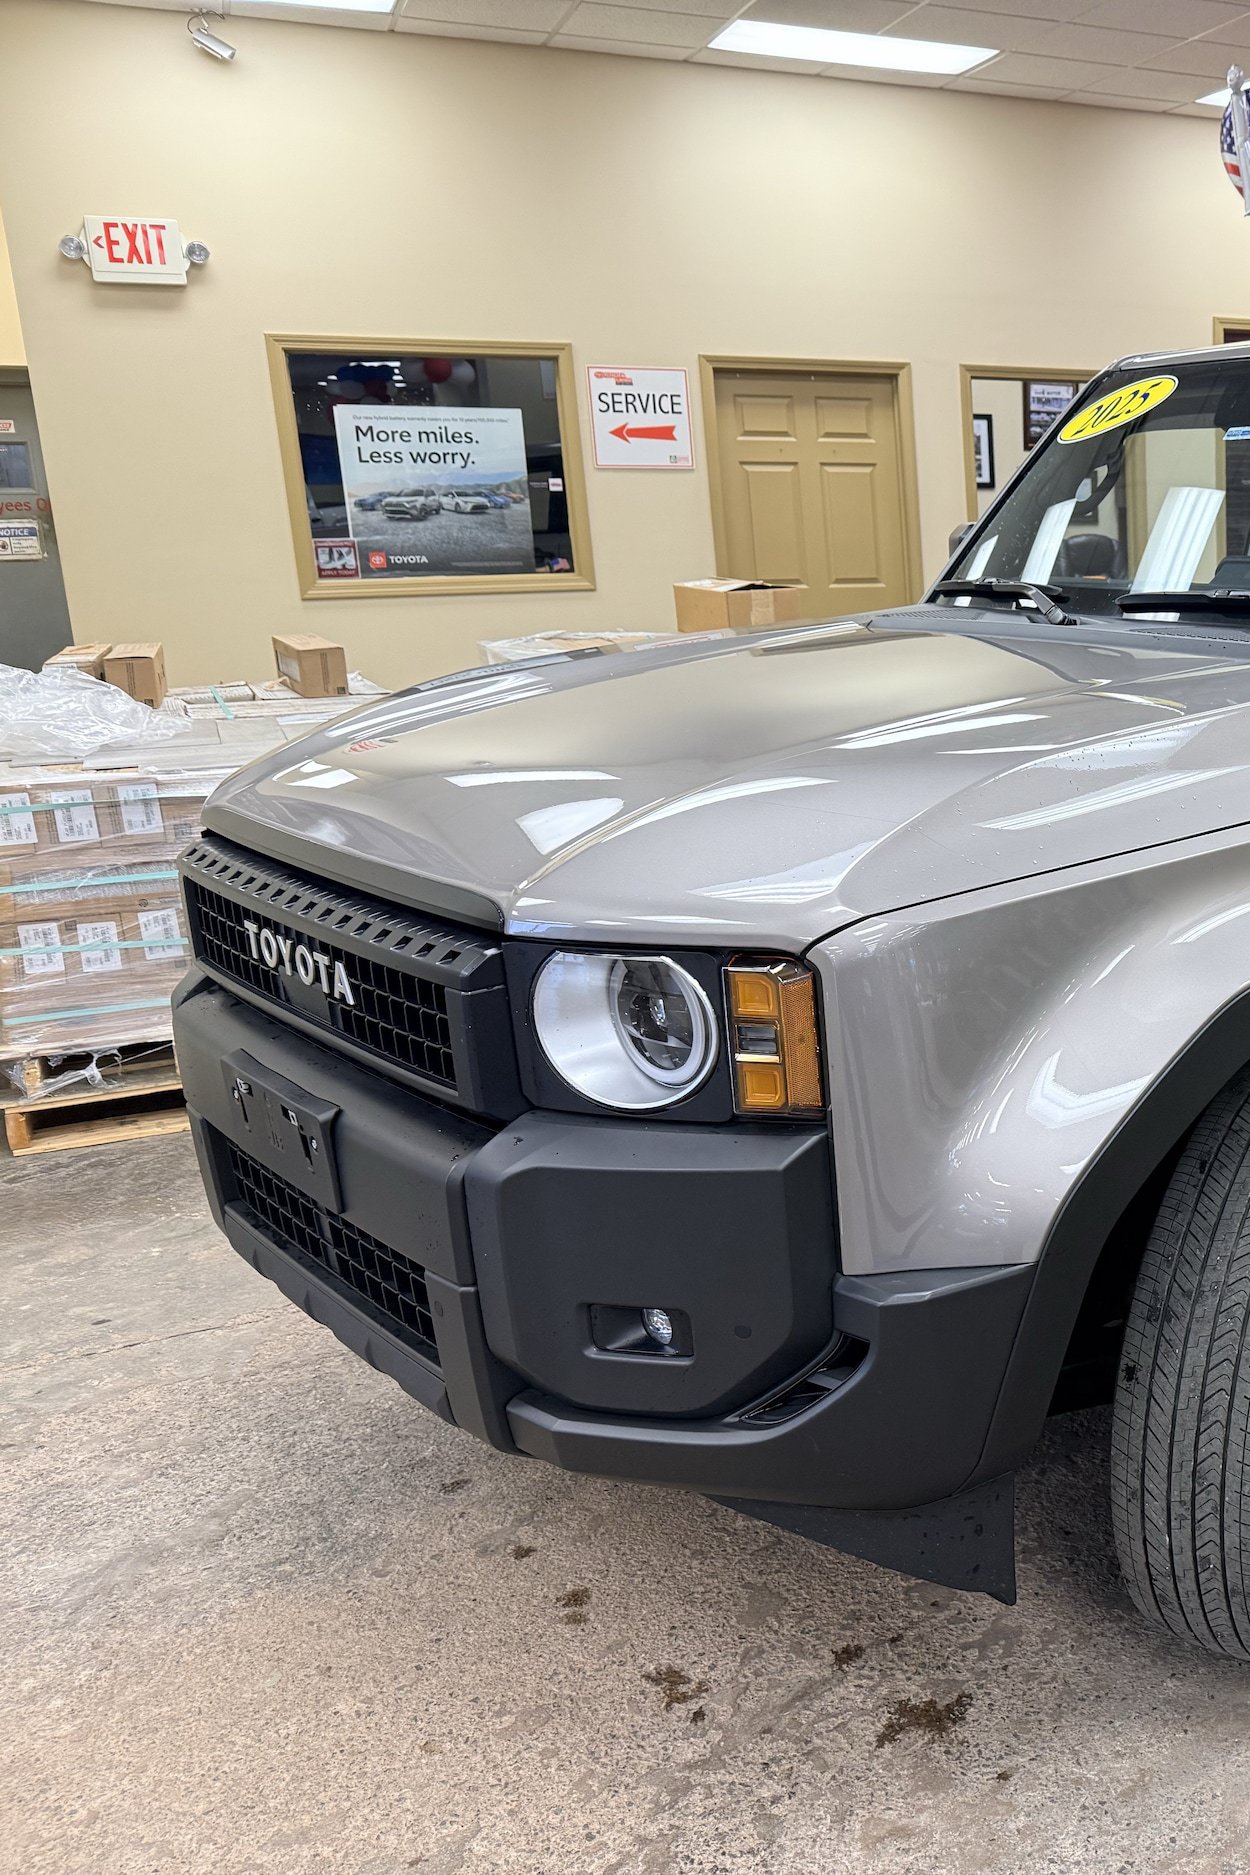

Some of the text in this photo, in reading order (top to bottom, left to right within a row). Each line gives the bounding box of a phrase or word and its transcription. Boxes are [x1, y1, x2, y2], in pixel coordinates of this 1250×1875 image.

[103, 222, 166, 265] EXIT
[598, 392, 682, 415] SERVICE
[1070, 381, 1163, 437] 2025
[354, 425, 479, 445] More miles.
[357, 446, 476, 469] Less worry.
[389, 555, 429, 564] TOYOTA
[243, 919, 355, 1006] TOYOTA
